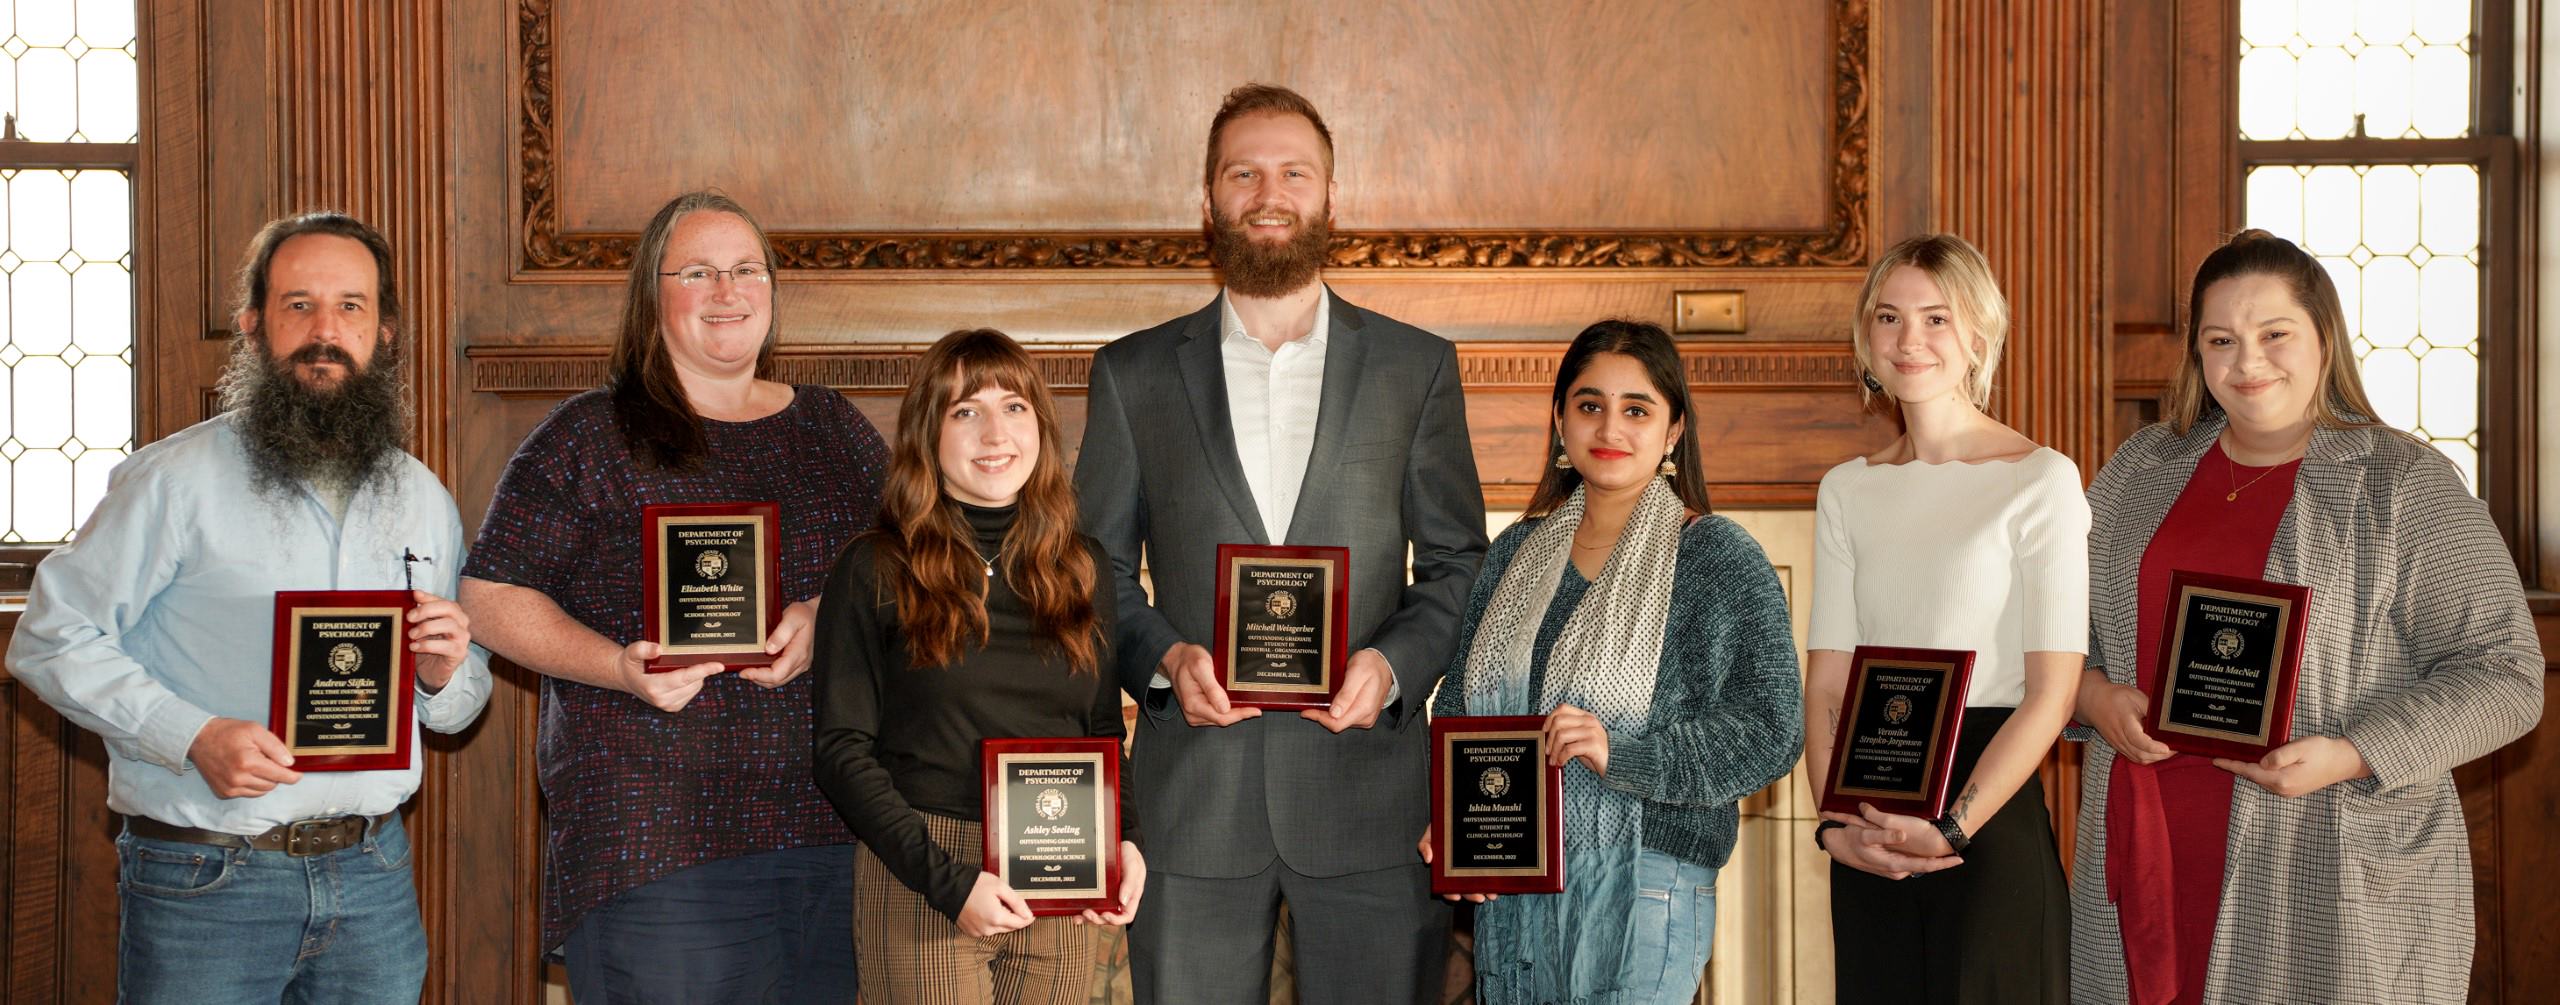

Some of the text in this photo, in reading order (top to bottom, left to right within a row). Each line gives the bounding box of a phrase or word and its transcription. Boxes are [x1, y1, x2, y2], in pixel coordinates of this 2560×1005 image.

[2200, 604, 2268, 619] DEPARTMENT OF
[2205, 613, 2260, 627] PSYCHOLOGY
[1246, 623, 1275, 632] Mitchell
[2188, 661, 2260, 678] Amanda MacNeil
[313, 679, 375, 688] Andrew Slifkin
[1877, 675, 1922, 684] DEPARTMENT
[2189, 673, 2255, 688] OUTSTANDING GRADUATE
[1880, 683, 1926, 692] PSYCHOLOGY
[2204, 684, 2229, 693] STUDENT
[2194, 689, 2233, 701] DEVELOPMENT
[1878, 728, 1908, 737] Veronika
[1469, 803, 1522, 812] Ishita Munshi
[1024, 826, 1051, 836] Ashley
